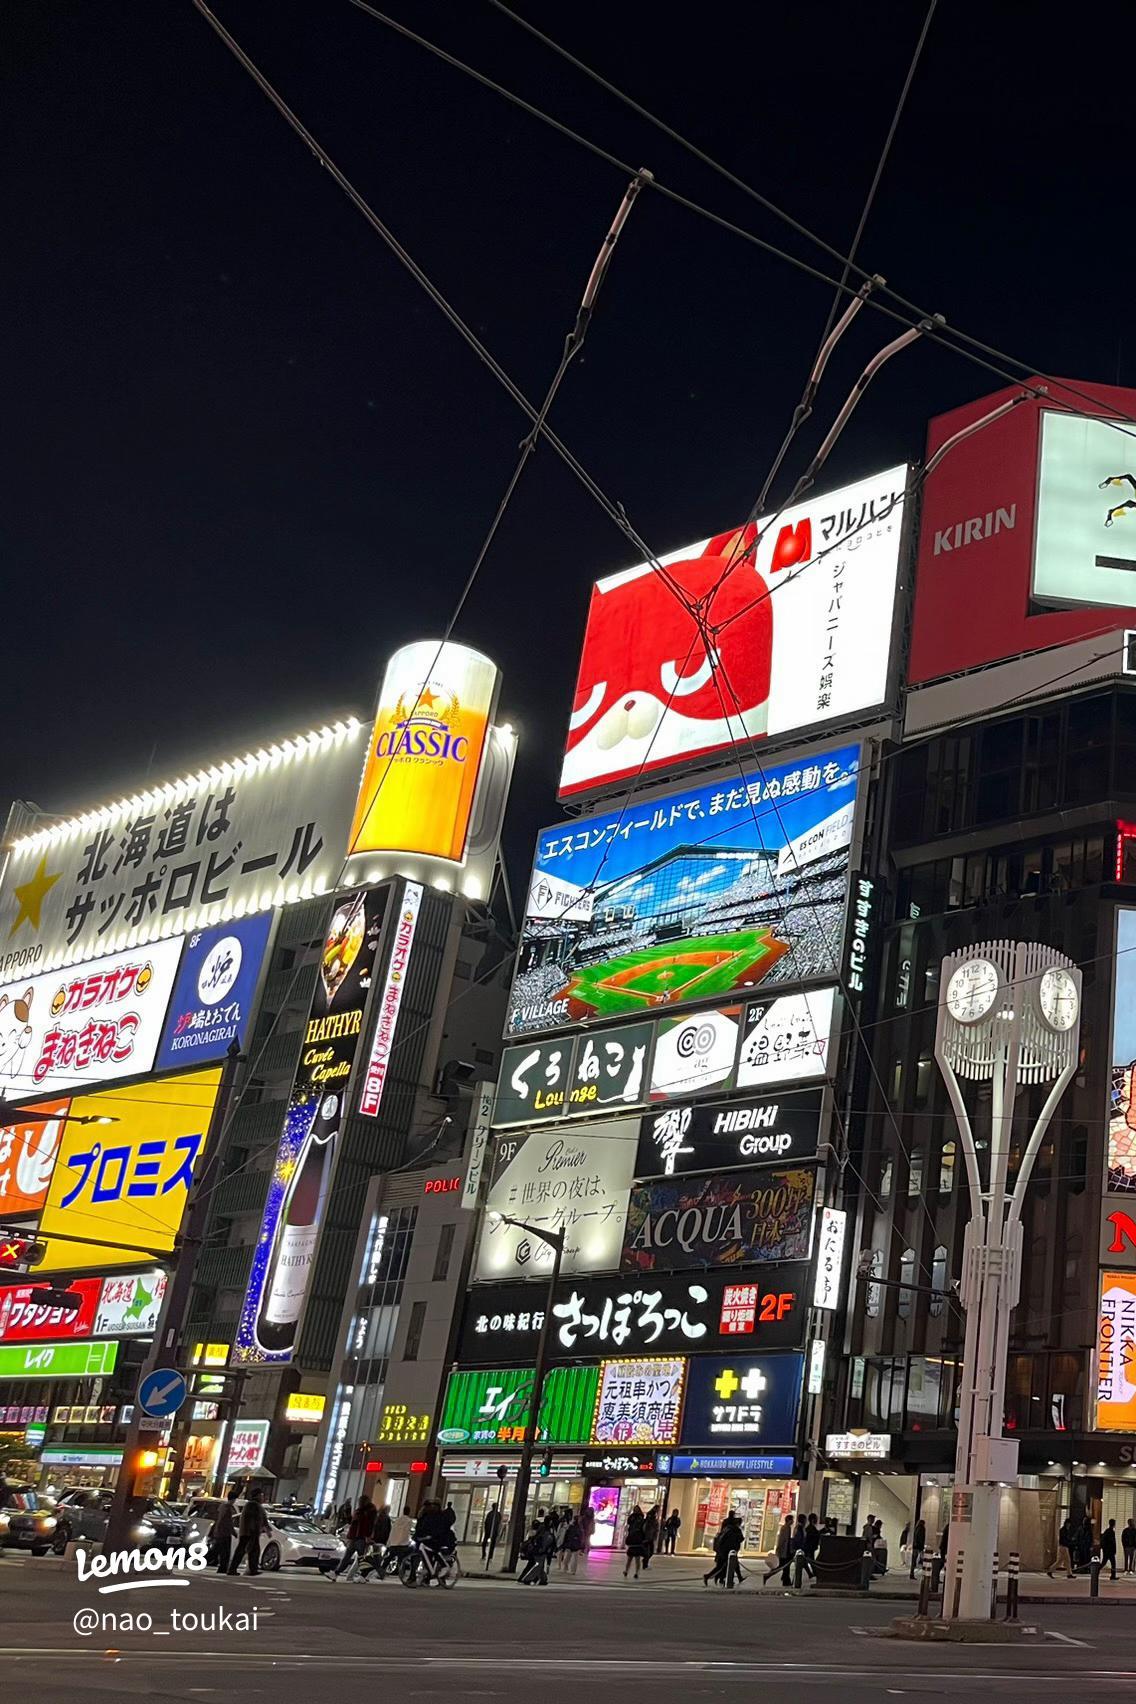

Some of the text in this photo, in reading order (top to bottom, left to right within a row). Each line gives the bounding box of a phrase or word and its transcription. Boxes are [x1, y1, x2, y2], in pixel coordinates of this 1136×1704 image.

[821, 492, 895, 541] マルハン
[934, 504, 1017, 556] KIRIN
[817, 561, 848, 710] ジャパニーズ娯楽
[376, 729, 469, 762] CLASSIC
[76, 787, 236, 886] 北海道は
[66, 821, 323, 946] サッポロビール
[555, 890, 591, 911] FIGHTERS
[0, 943, 43, 973] APPORO
[394, 921, 413, 972] カラオケ
[64, 966, 140, 1011] カラオケ
[305, 1010, 362, 1043] HATHYR
[521, 998, 569, 1020] VILLAGE
[748, 1007, 764, 1022] 2F
[33, 1015, 139, 1081] まねきねこ
[311, 1064, 351, 1082] Capella
[511, 1040, 621, 1099] くろねこ
[534, 1086, 597, 1109] Lounge
[714, 1106, 779, 1134] HIBIKI
[499, 1142, 517, 1162] 9F
[739, 1133, 793, 1156] Group
[60, 1133, 203, 1209] プロミス
[425, 1178, 460, 1192] POLIC
[631, 1204, 743, 1253] ACQUA
[475, 1311, 545, 1333] 北の味紀行
[552, 1285, 709, 1348] さっぽろっこ
[759, 1293, 794, 1321] 2F
[1098, 1299, 1116, 1401] FRONTIER
[1120, 1300, 1136, 1366] NIKKA
